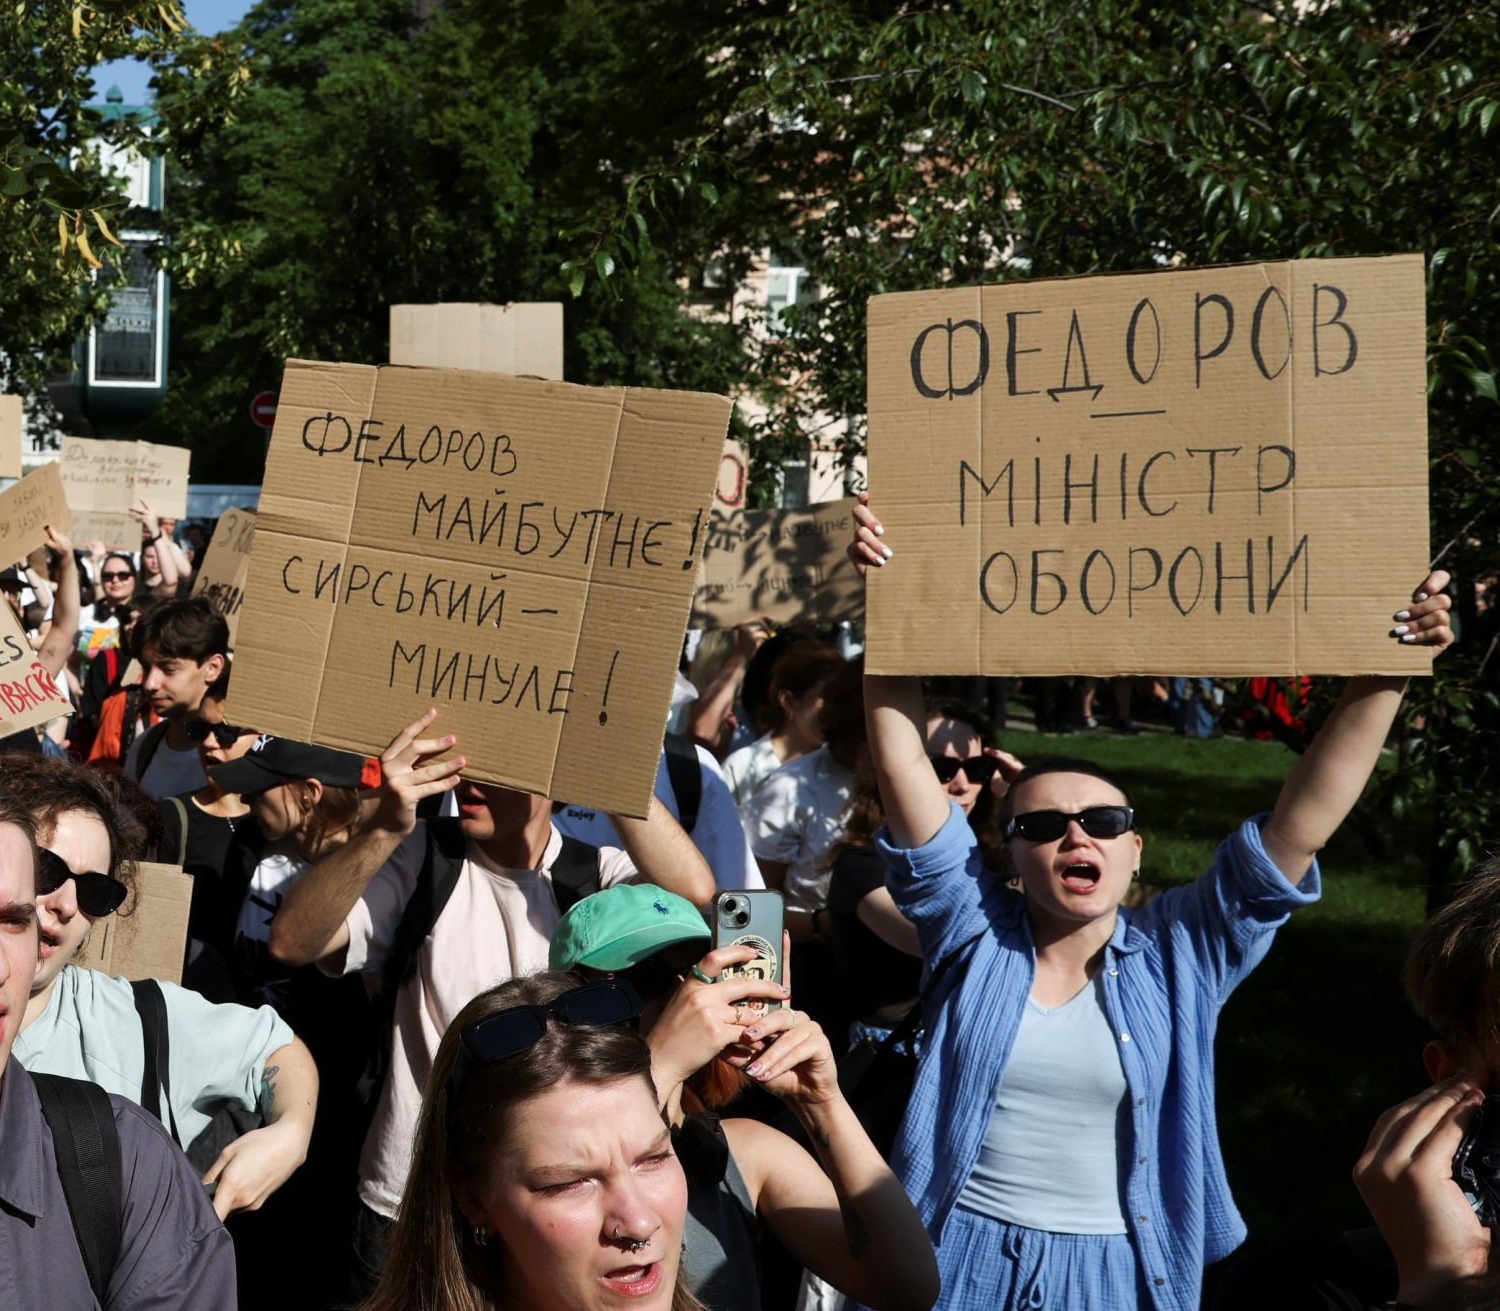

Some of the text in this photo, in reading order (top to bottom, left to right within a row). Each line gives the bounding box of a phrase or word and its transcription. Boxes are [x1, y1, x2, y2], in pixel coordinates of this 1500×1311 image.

[909, 282, 1359, 402] ФЕДОРОВ
[301, 411, 518, 477] ФЕДОРОВ
[959, 436, 1296, 528] МІНІСТР
[282, 555, 506, 629] СИРСЬКИЙ
[979, 533, 1309, 619] ОБОРОНИ
[567, 808, 596, 821] Enjoy
